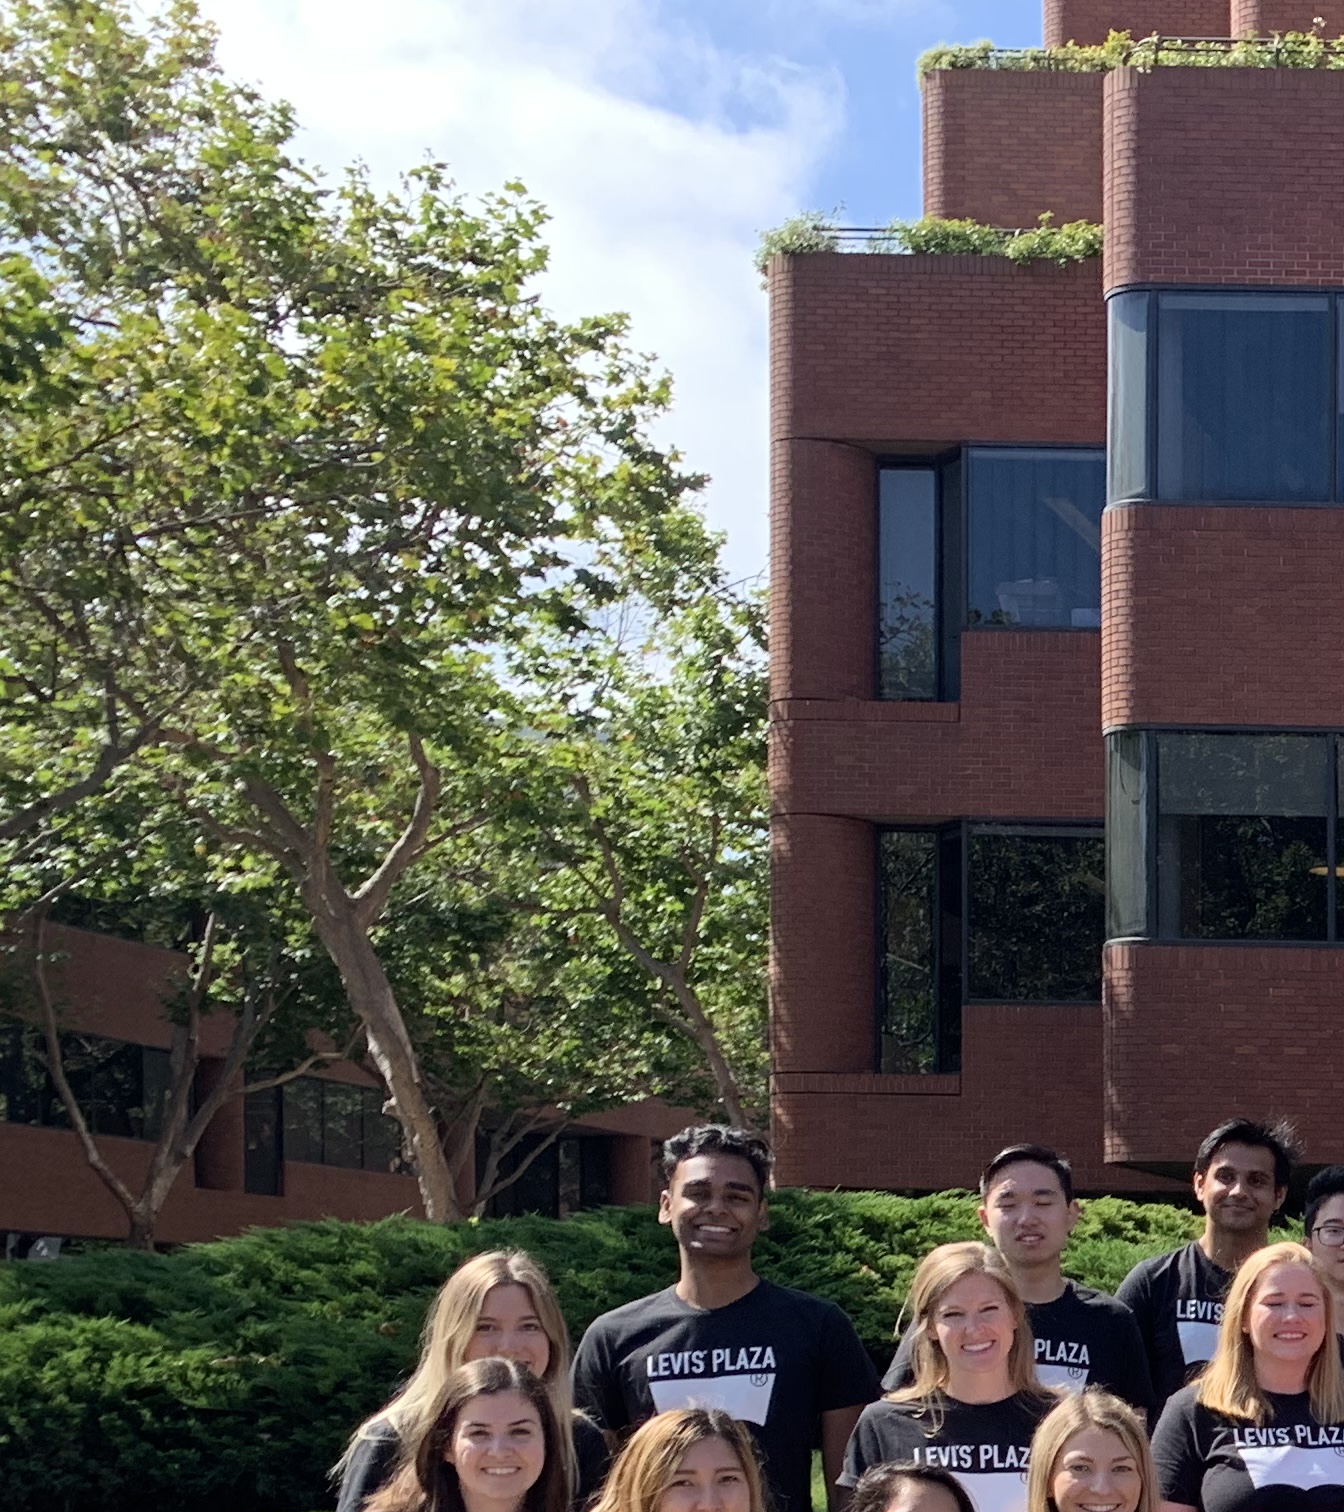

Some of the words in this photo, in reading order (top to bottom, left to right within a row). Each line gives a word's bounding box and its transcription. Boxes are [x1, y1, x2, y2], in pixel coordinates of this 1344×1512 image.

[712, 1346, 777, 1373] PLAZA
[1033, 1337, 1090, 1365] PLAZA
[979, 1444, 1031, 1469] PLAZ
